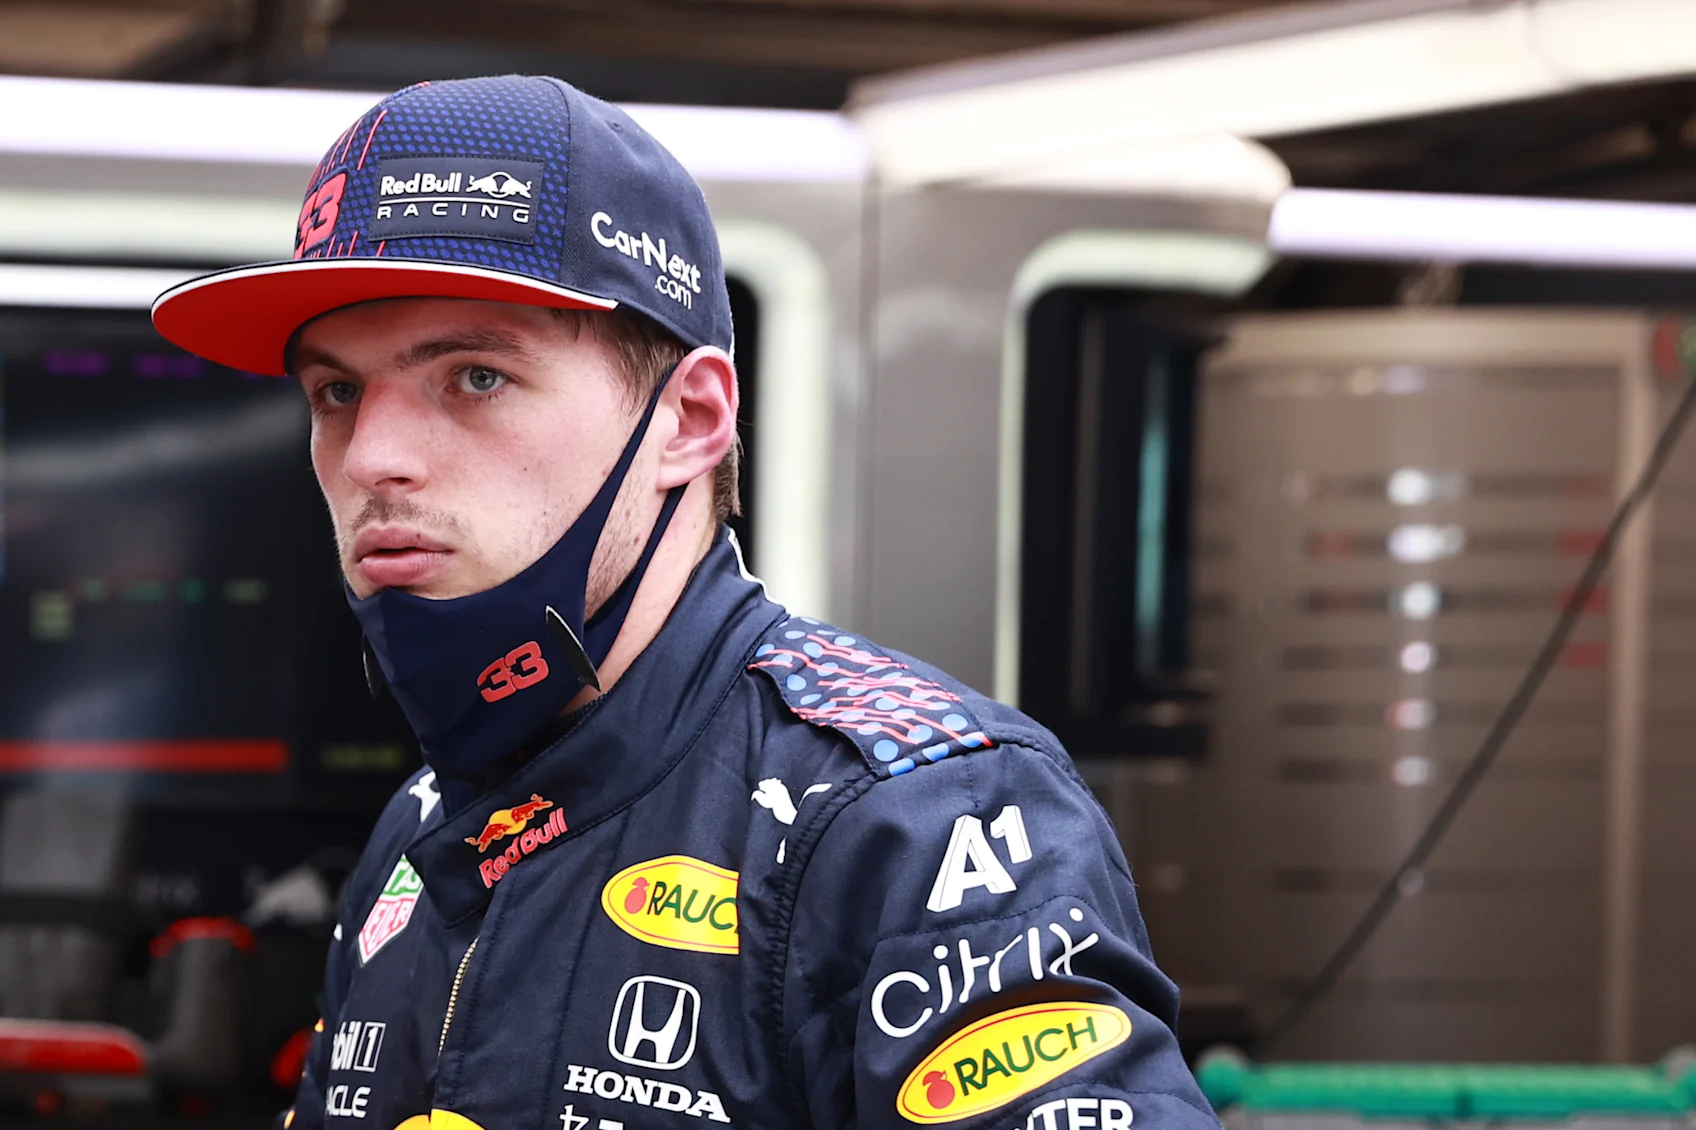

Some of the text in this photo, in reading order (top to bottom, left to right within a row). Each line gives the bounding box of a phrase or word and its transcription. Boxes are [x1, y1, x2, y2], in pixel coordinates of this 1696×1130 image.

[377, 203, 529, 223] RACING
[591, 212, 701, 293] CarNext
[477, 641, 549, 703] 33
[926, 805, 1033, 912] A1
[647, 881, 738, 933] RAUC
[953, 1017, 1098, 1097] RAUCH
[563, 1064, 731, 1124] HONDA
